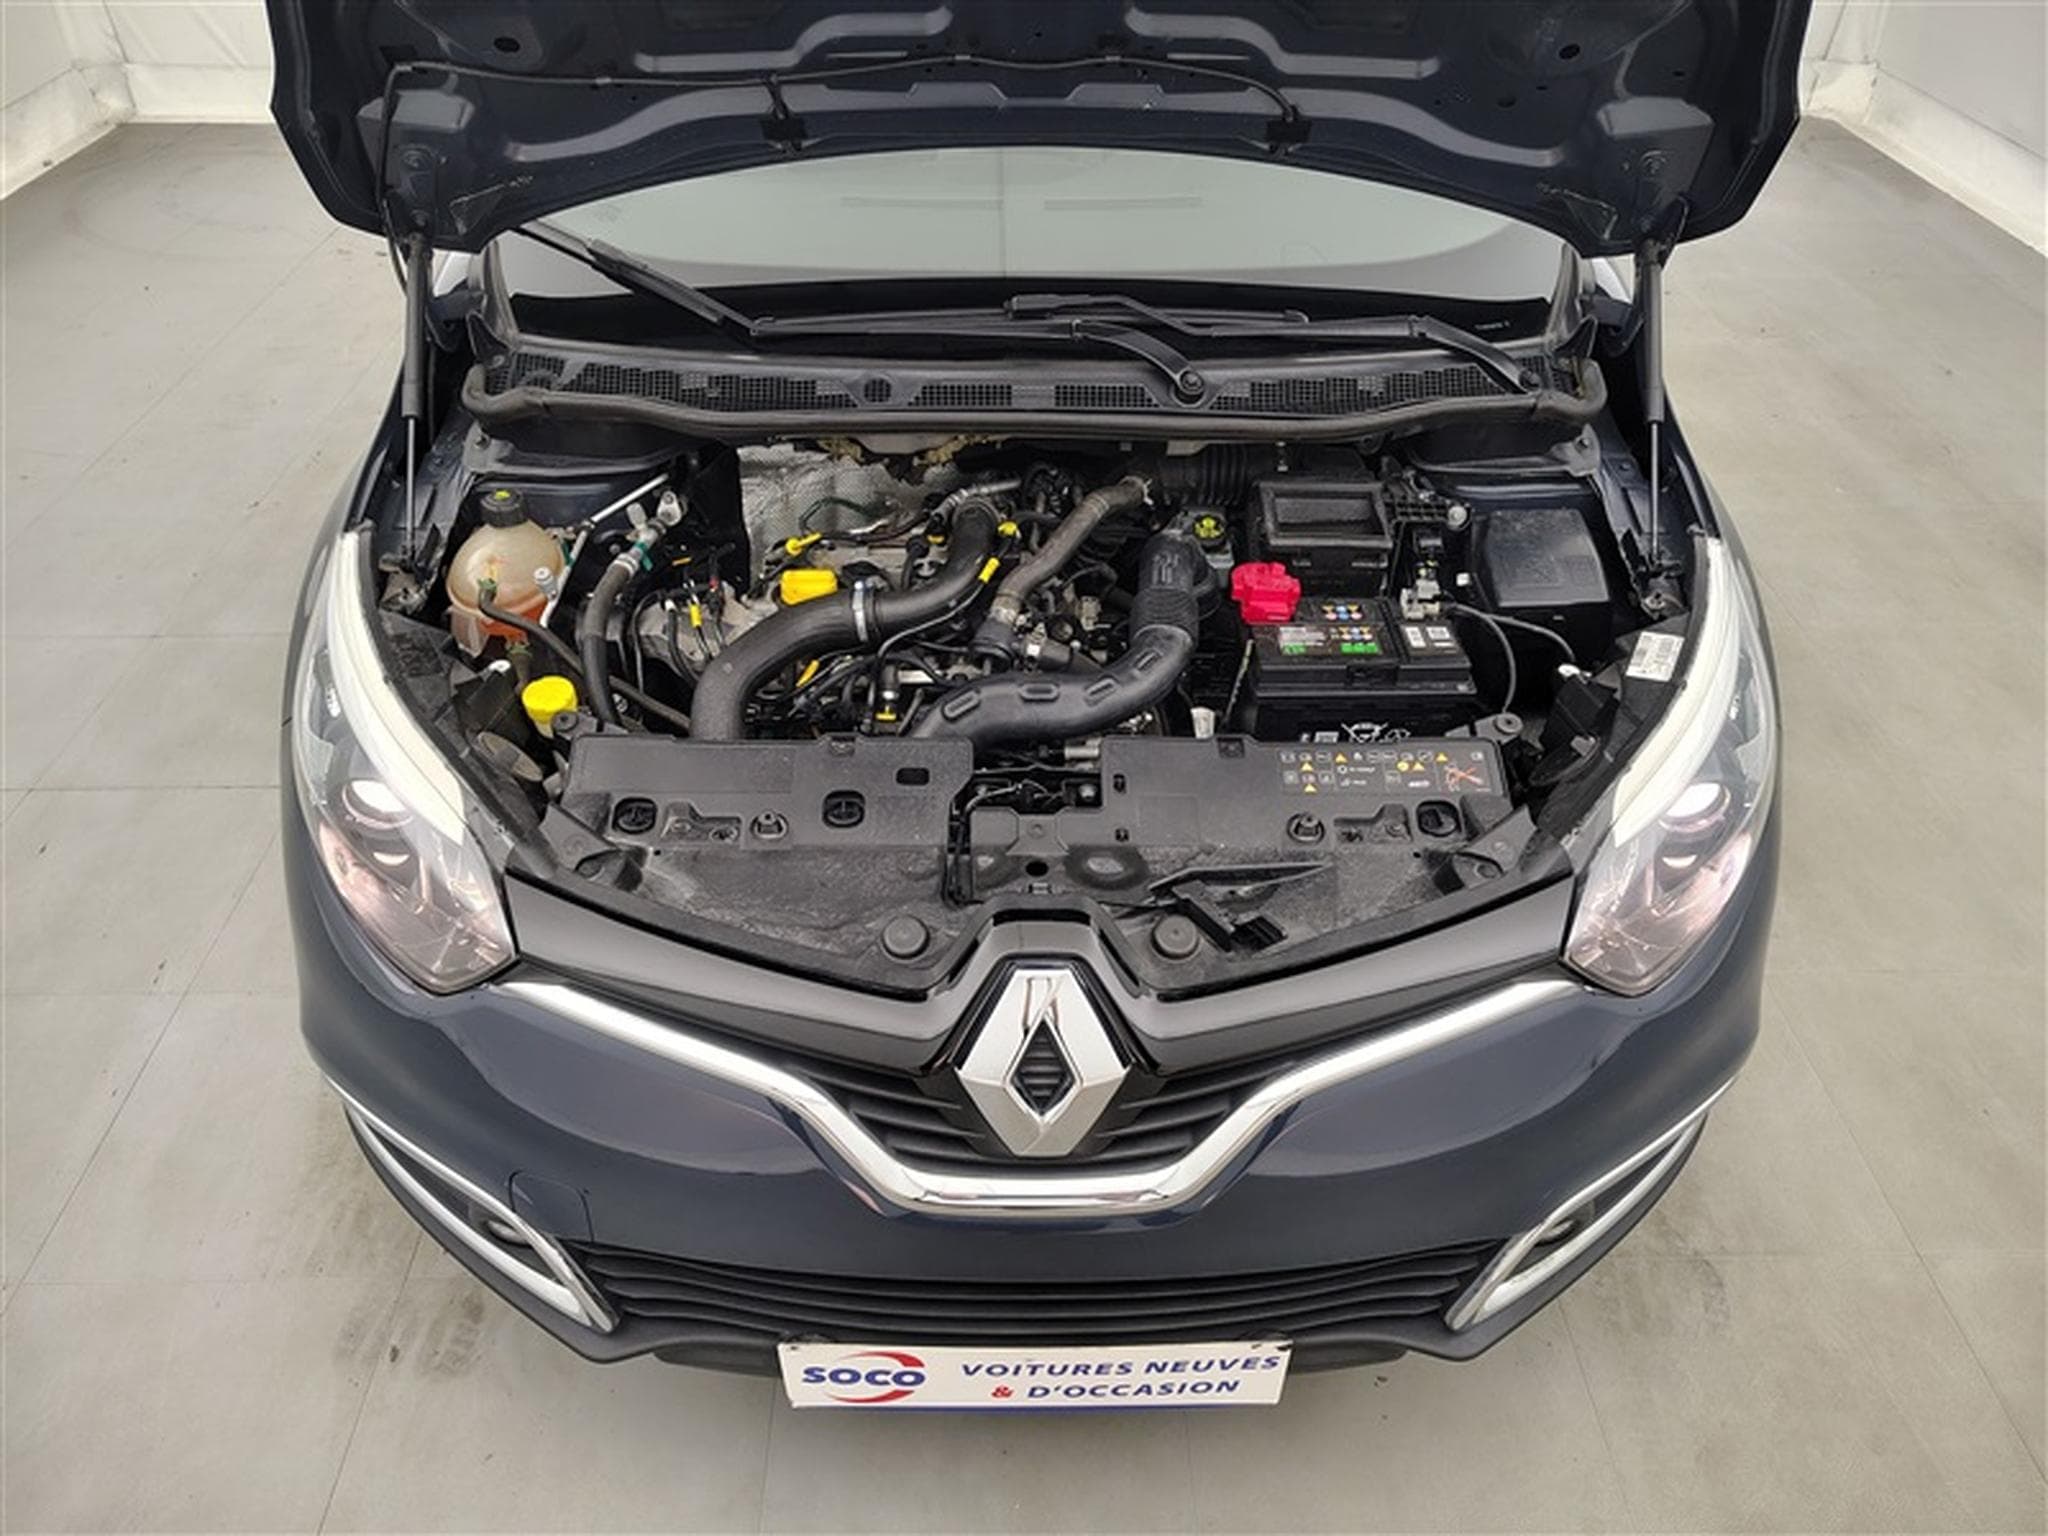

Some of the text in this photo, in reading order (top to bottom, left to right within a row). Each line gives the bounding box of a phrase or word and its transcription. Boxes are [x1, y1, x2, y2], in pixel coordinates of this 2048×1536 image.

[802, 1366, 926, 1387] SOCO
[962, 1356, 1281, 1377] VOITURES NEUVES
[991, 1380, 1241, 1398] & D'OCCASION
